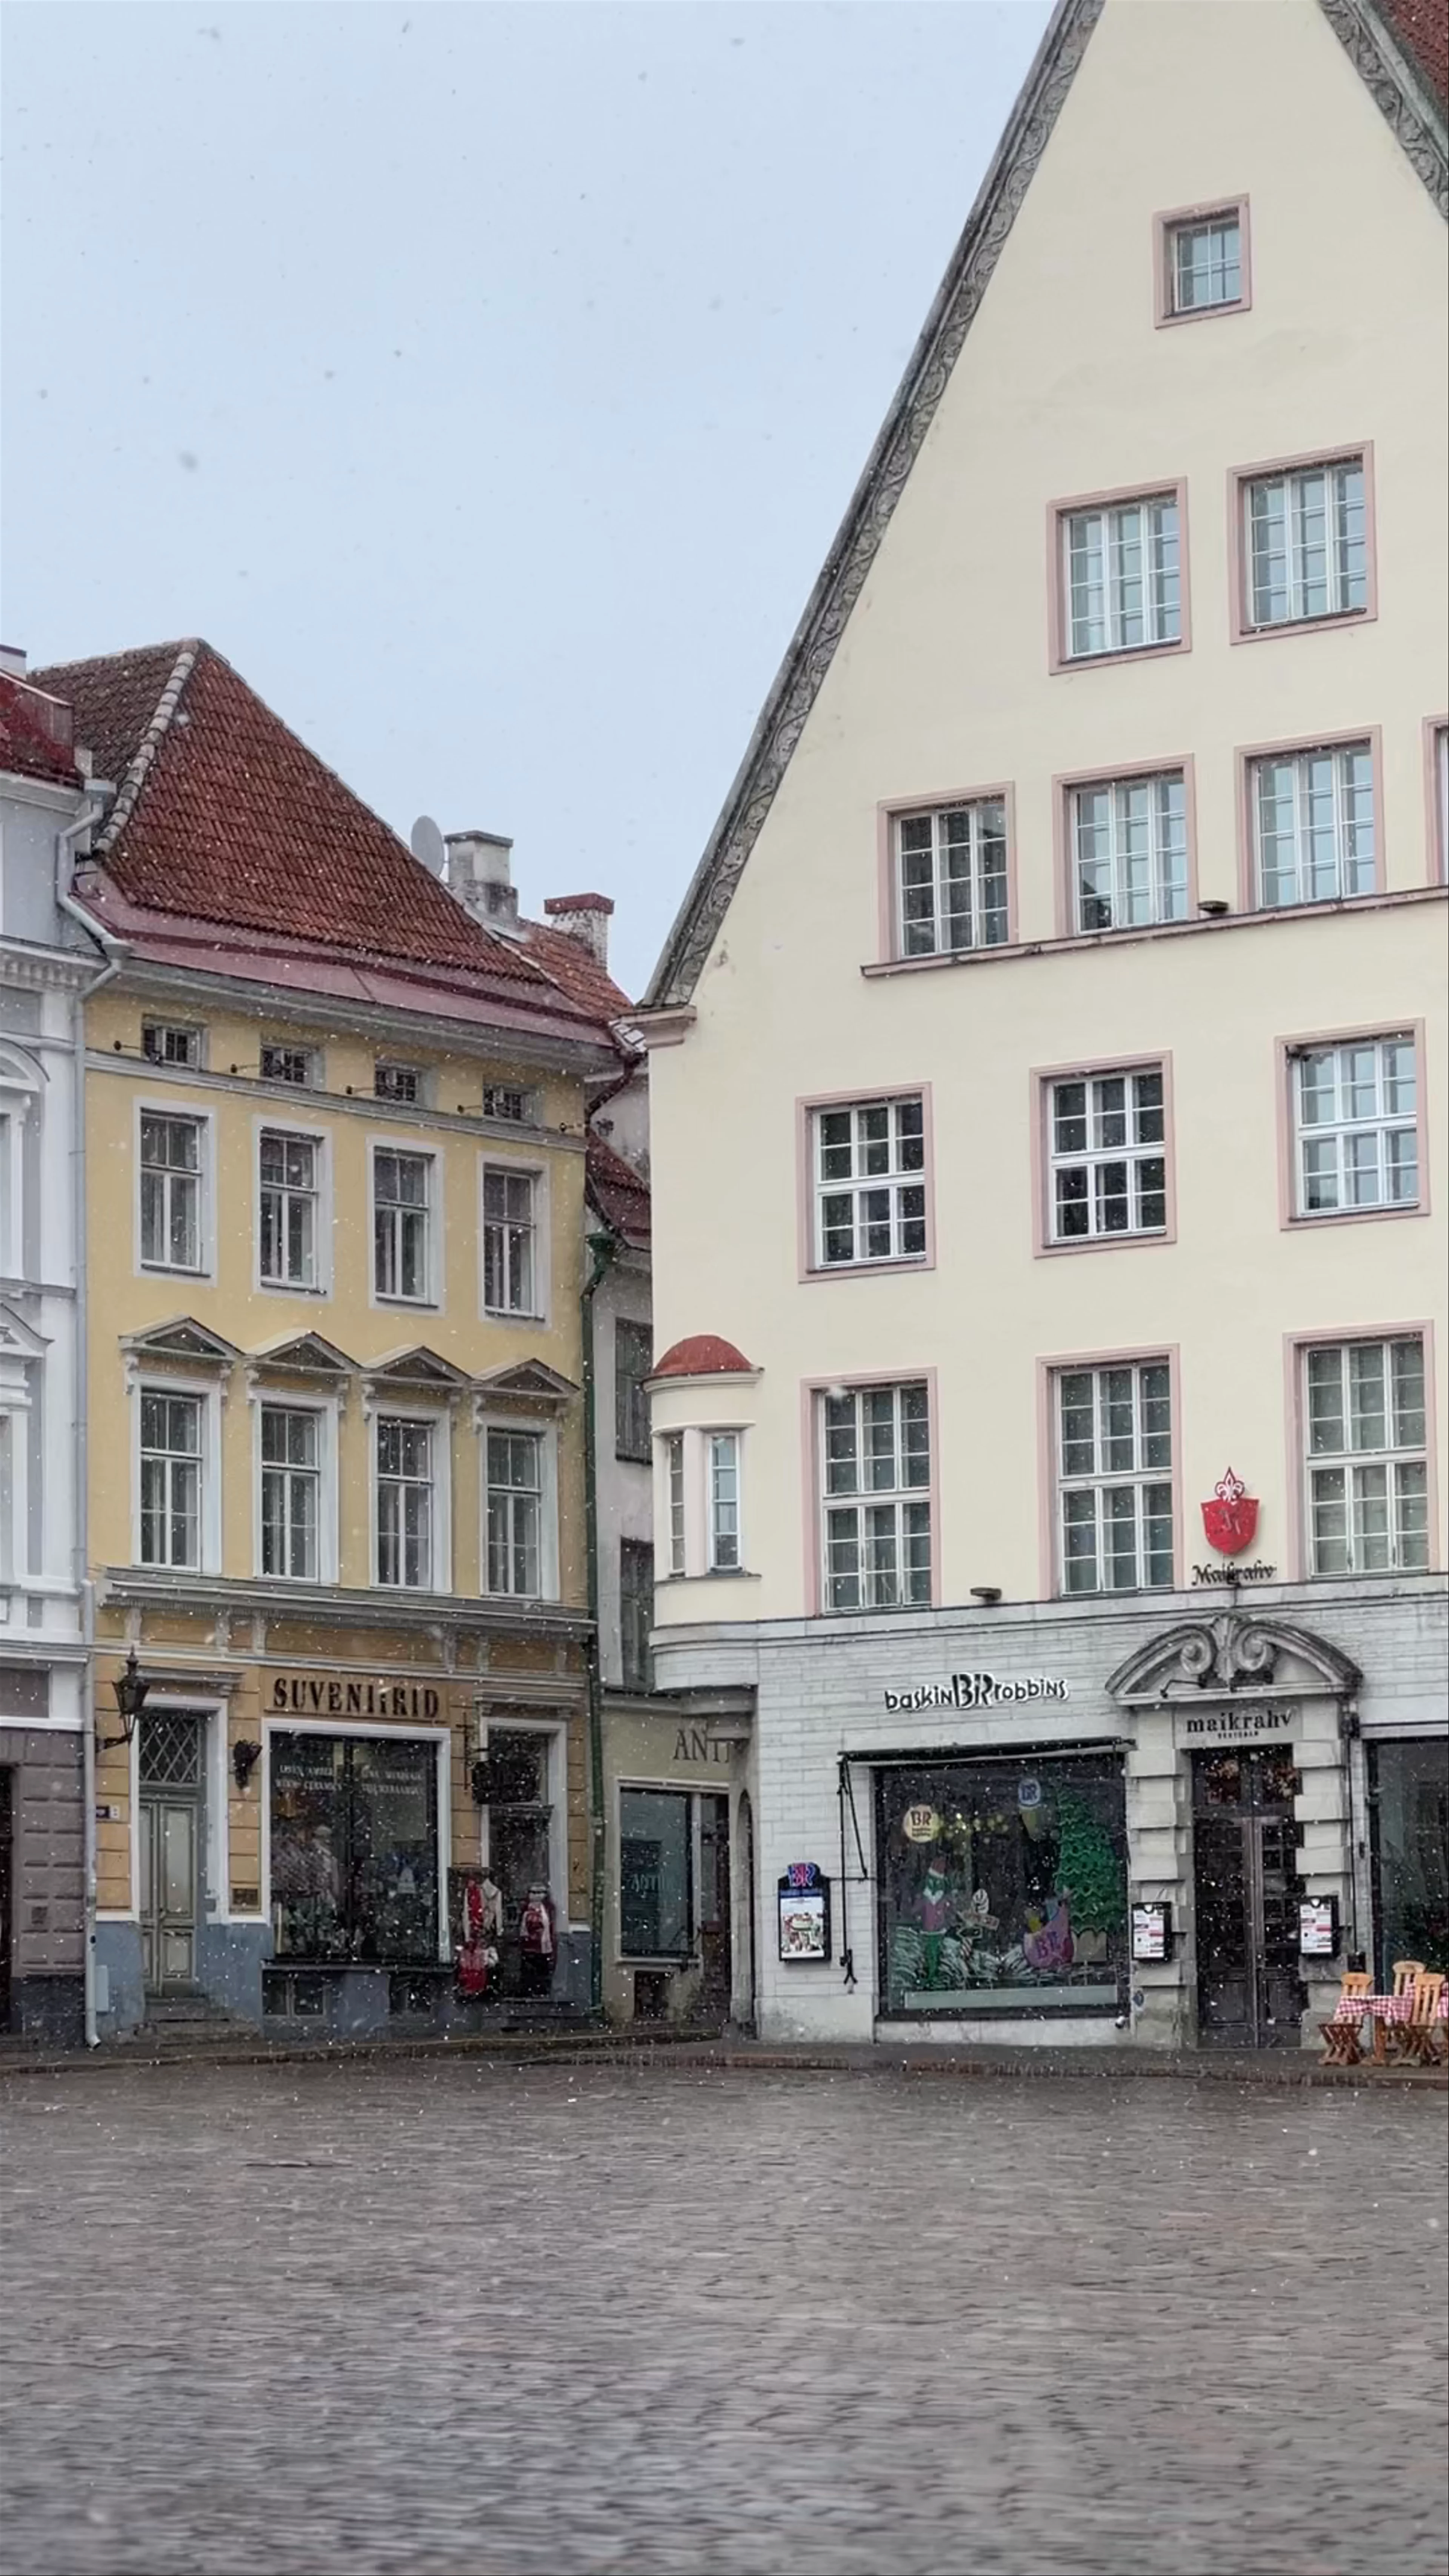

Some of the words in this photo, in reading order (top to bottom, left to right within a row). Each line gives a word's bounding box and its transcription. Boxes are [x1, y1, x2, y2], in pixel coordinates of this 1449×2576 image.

[273, 1678, 439, 1718] SUVENIIRID
[1187, 1710, 1292, 1733] maikrahv
[910, 1811, 932, 1826] BR
